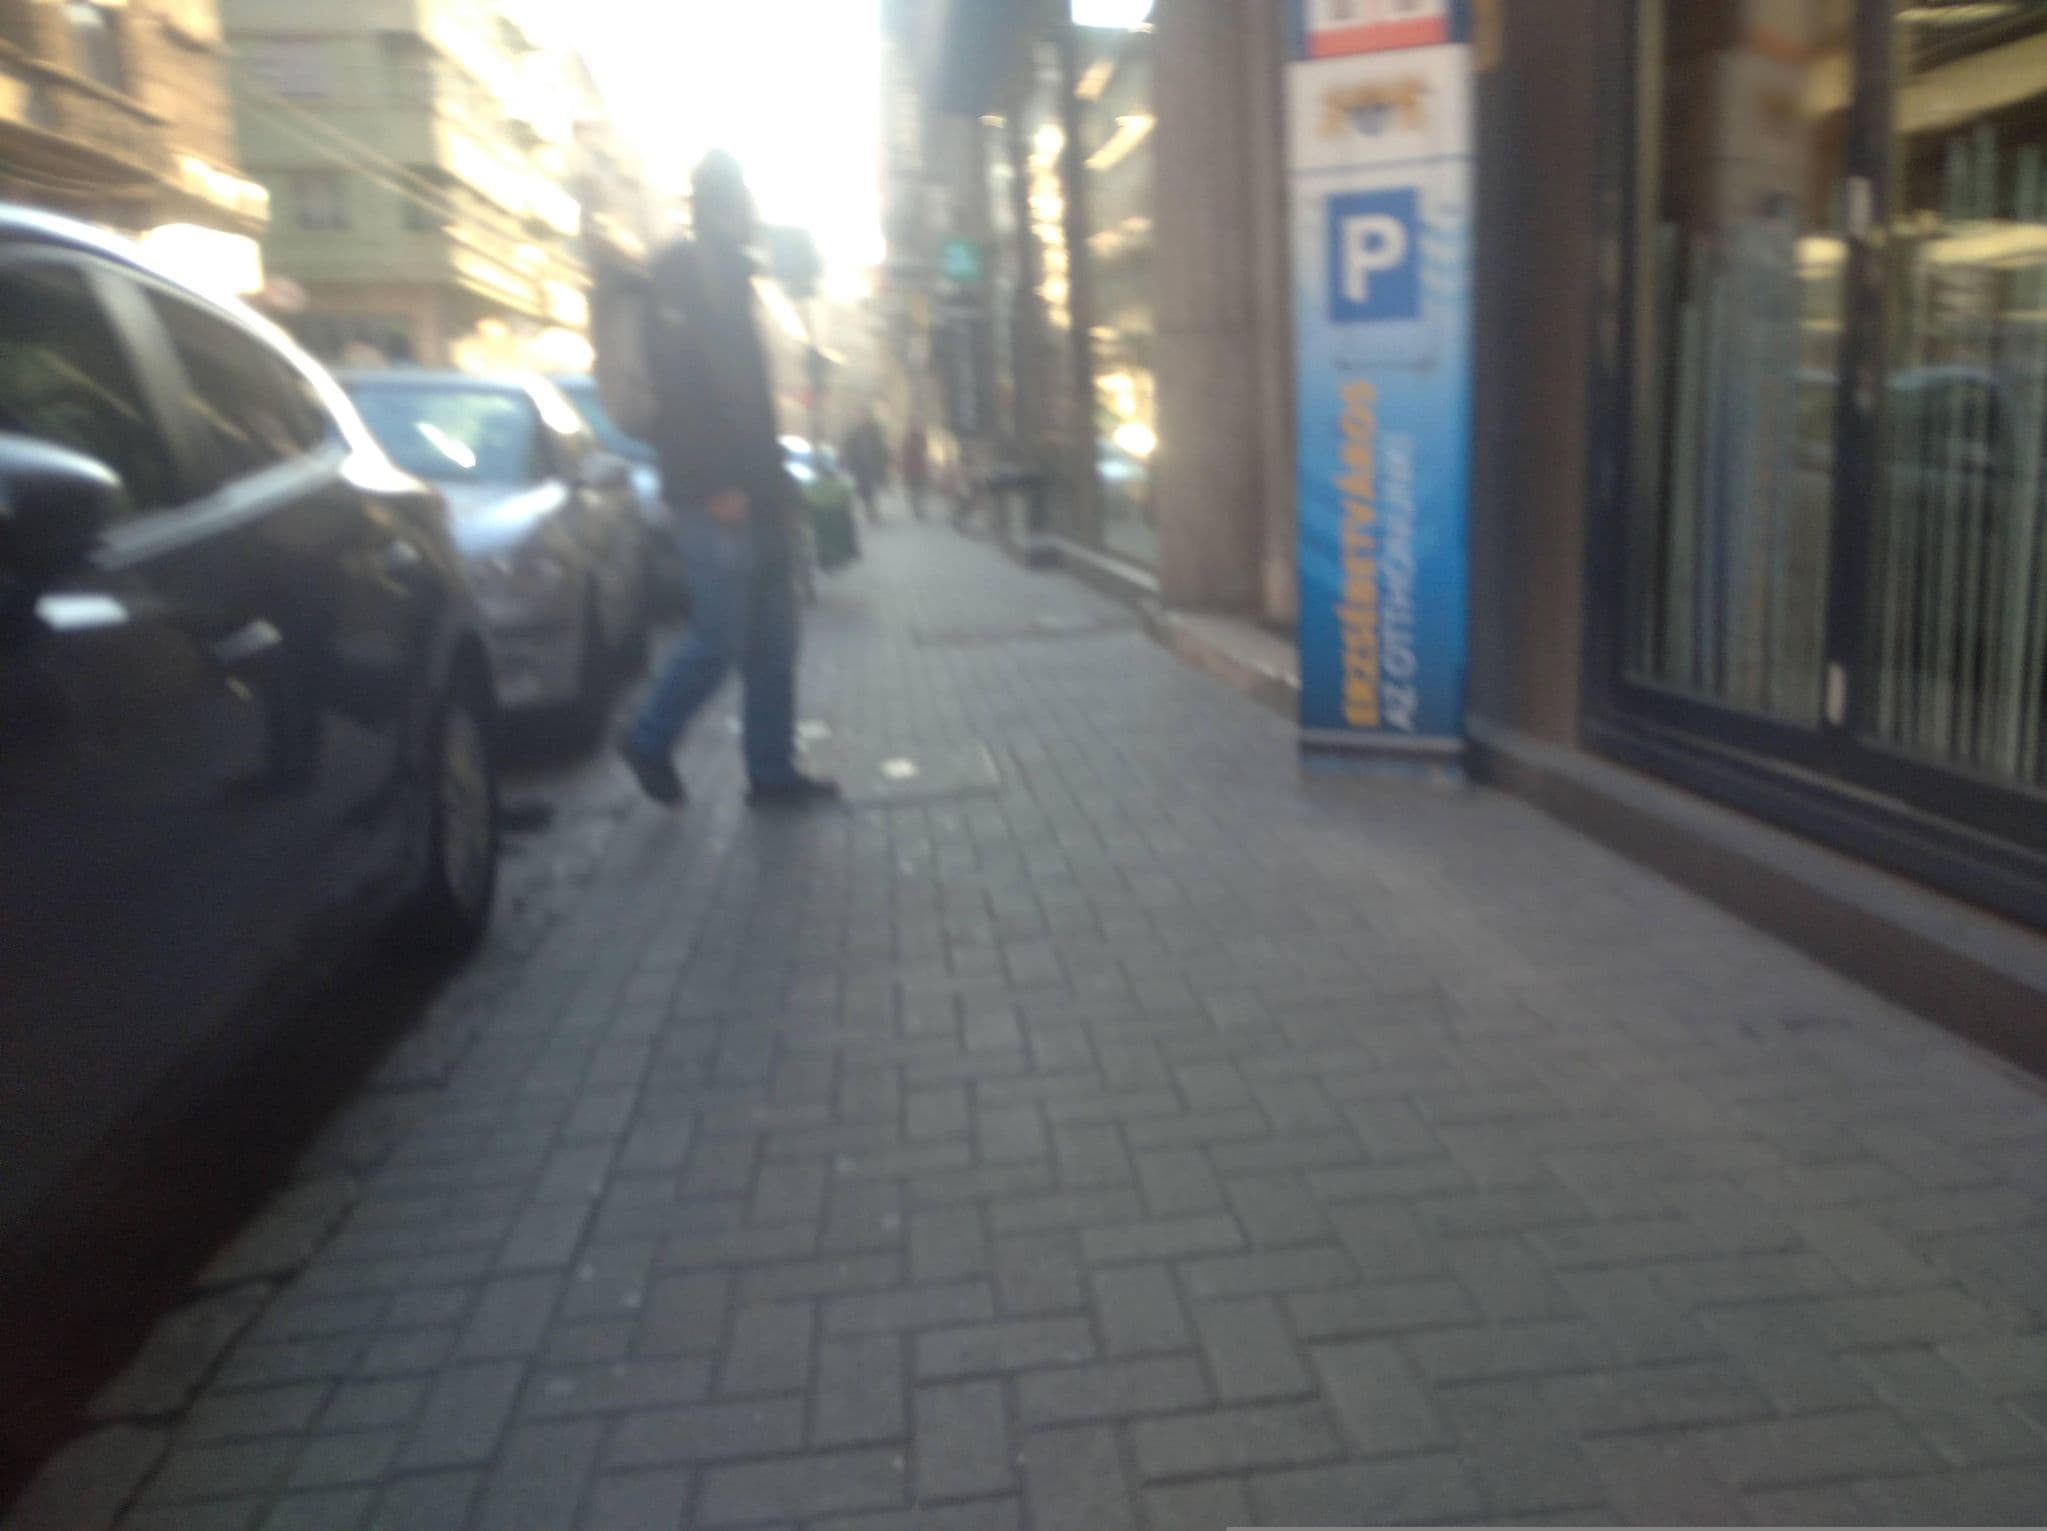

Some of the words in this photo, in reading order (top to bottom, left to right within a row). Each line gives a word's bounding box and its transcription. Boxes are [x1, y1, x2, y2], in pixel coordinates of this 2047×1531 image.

[1342, 213, 1406, 303] P
[1334, 379, 1379, 728] ERZSÉBETVÁROS
[1381, 683, 1418, 732] AZ
